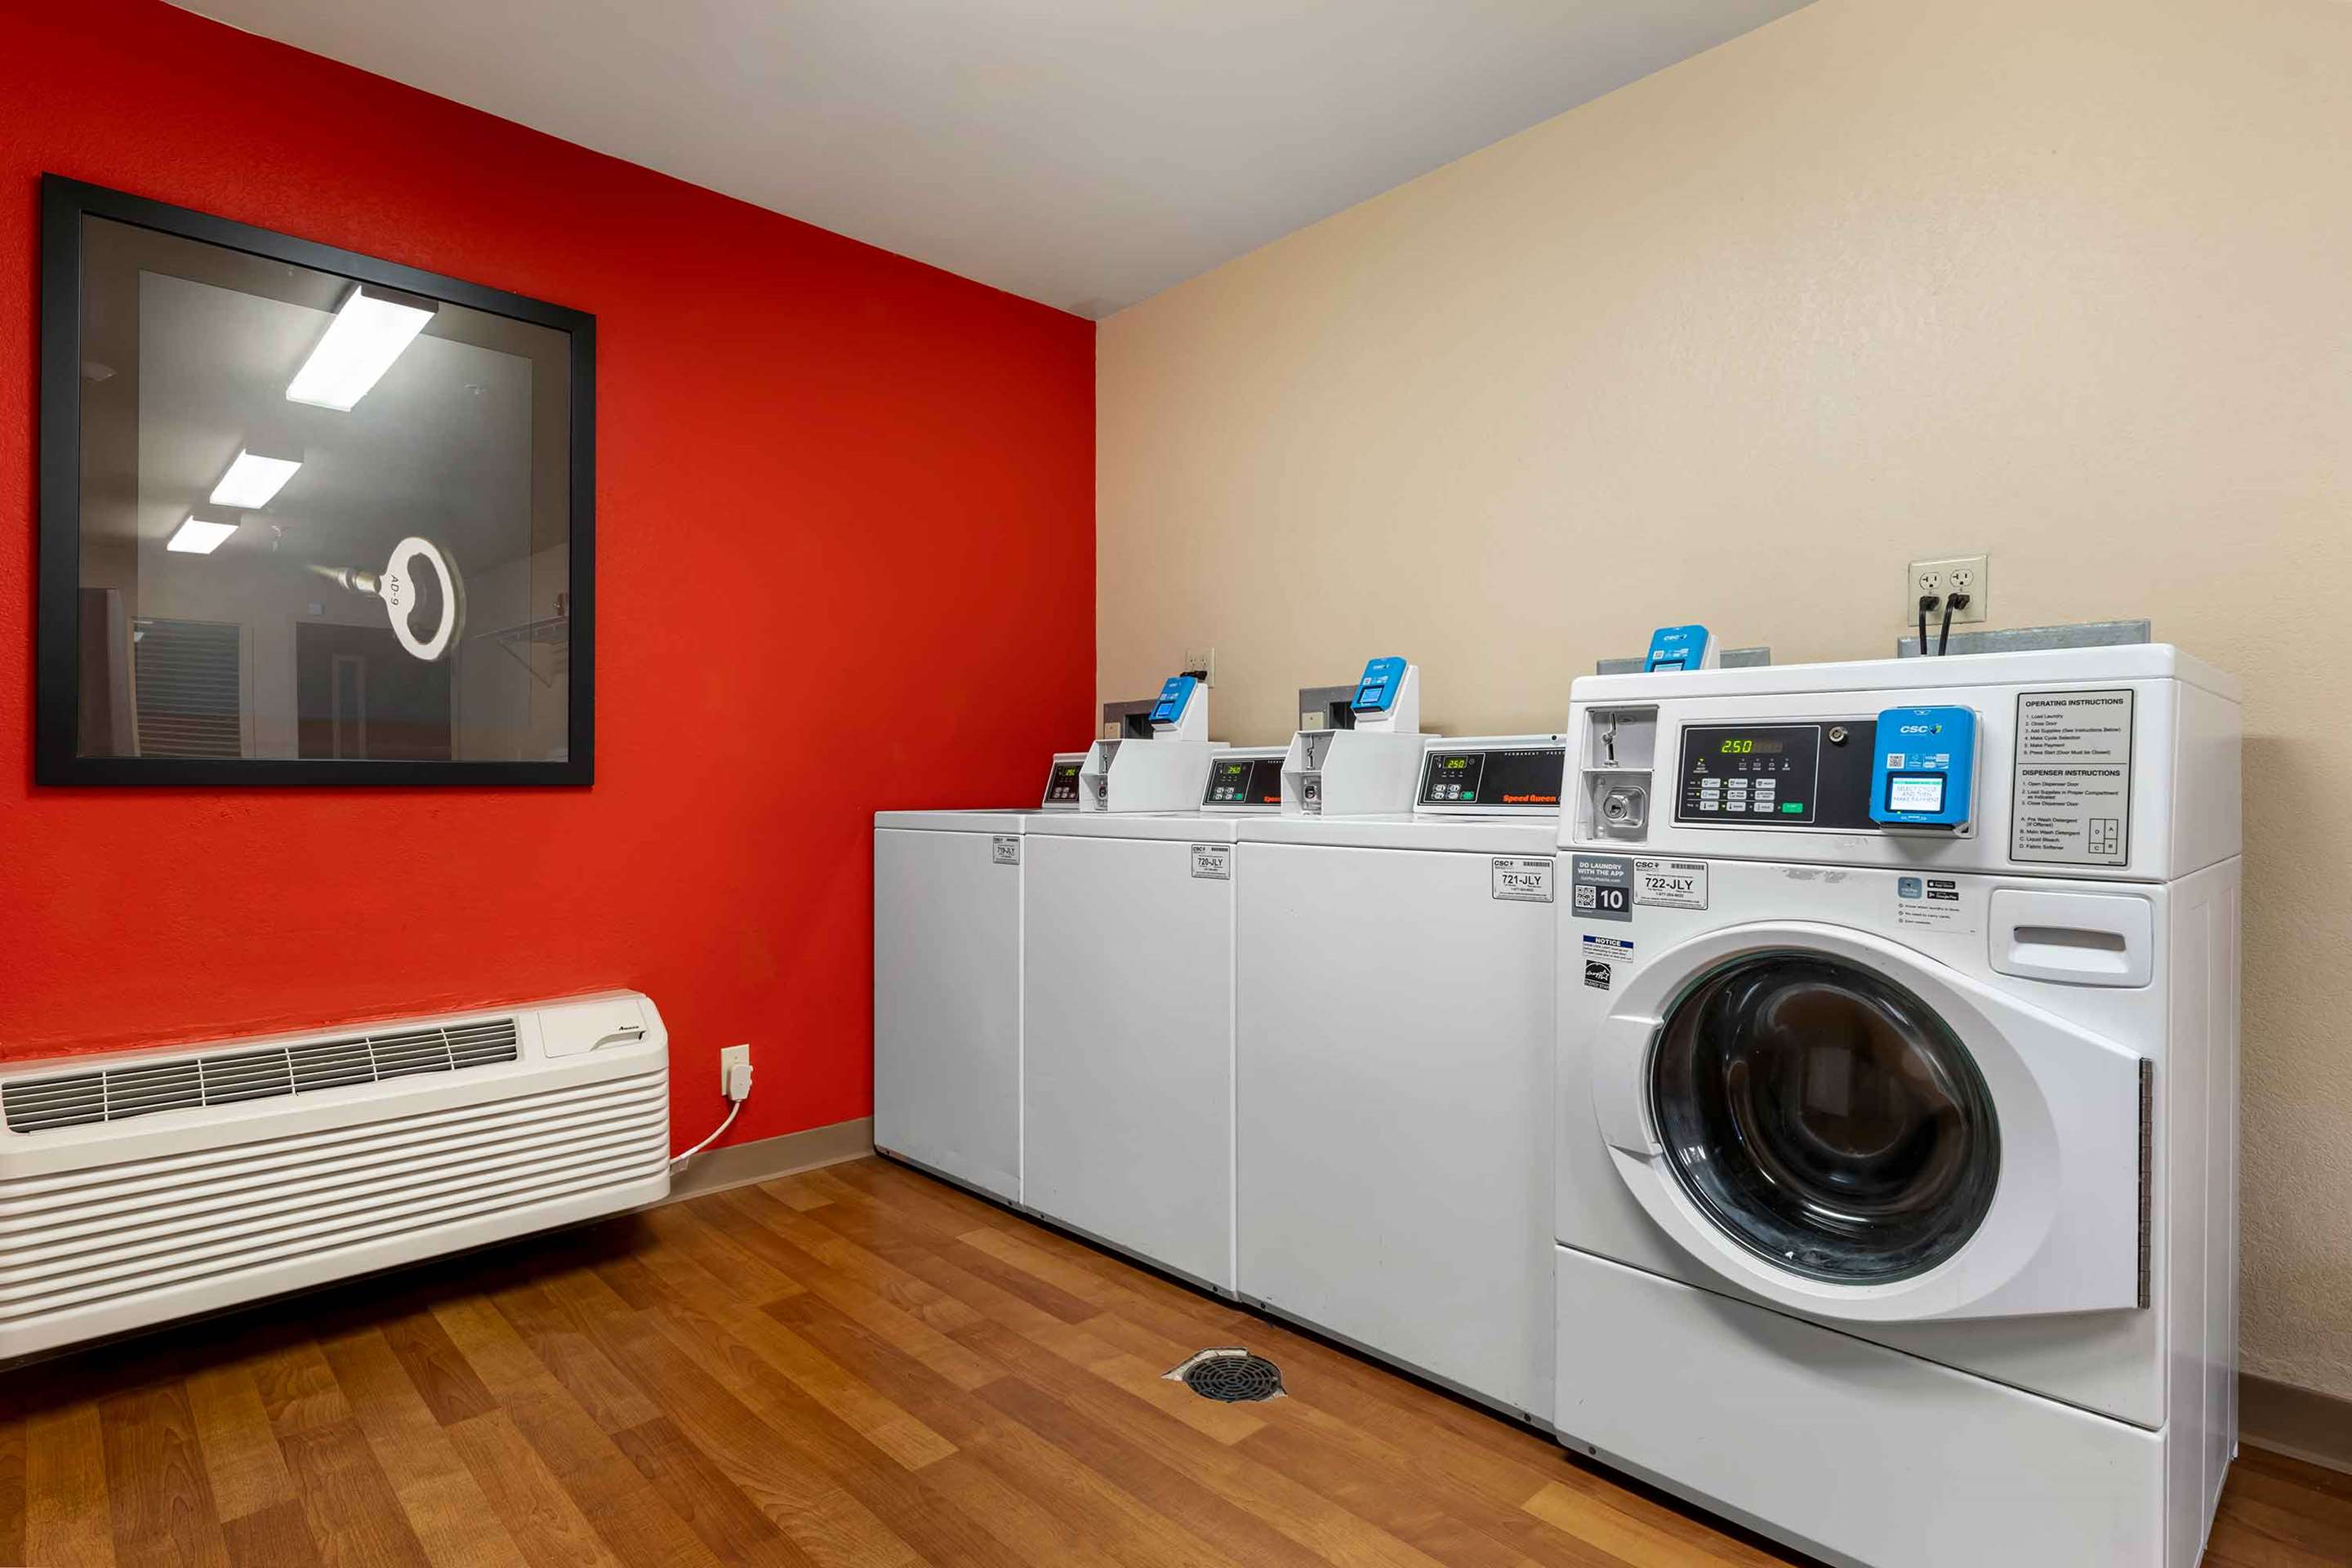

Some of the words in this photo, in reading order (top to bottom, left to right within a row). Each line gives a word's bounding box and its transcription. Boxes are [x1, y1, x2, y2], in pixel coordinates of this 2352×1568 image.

[1900, 725, 1928, 733] CSC
[1722, 741, 1753, 753] 2.50
[1503, 795, 1530, 803] Speed
[1198, 858, 1223, 866] 720-JLY
[1503, 875, 1541, 884] 721-JLY
[1646, 877, 1693, 890] 722-JLY
[1601, 890, 1623, 908] 10
[1595, 938, 1621, 946] NOTICE
